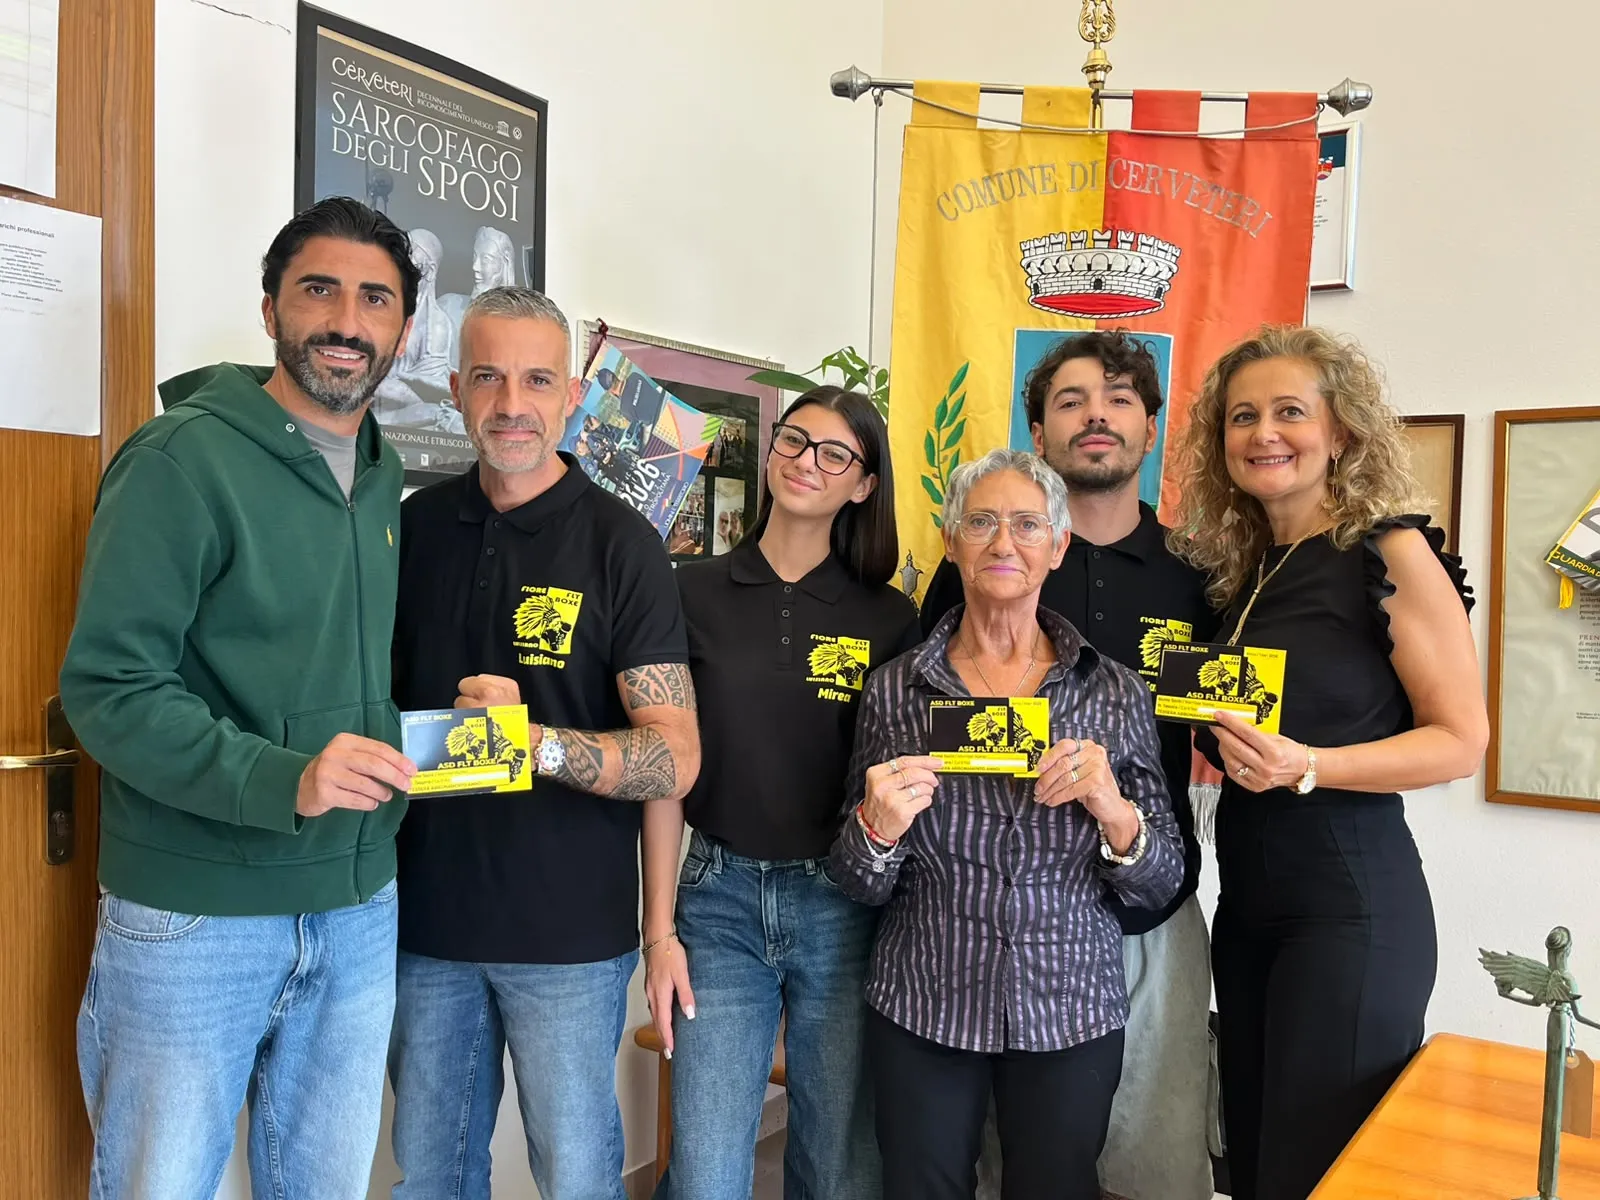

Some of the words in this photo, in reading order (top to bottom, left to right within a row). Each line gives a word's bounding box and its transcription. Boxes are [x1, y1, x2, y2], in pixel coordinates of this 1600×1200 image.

[417, 90, 452, 108] DECENNALE
[452, 103, 463, 112] DEL
[417, 98, 471, 123] RICONOSCIMENTO
[471, 117, 494, 131] UNESCO
[331, 91, 522, 181] SARCOFAGO
[332, 127, 409, 174] DEGLI
[418, 155, 519, 222] SPOSI
[937, 163, 1058, 221] COMUNE
[1069, 160, 1099, 192] DI
[1108, 157, 1274, 238] CERVETERI
[17, 226, 55, 238] professionali
[384, 431, 430, 444] NAZIONALE
[431, 437, 464, 448] ETRUSCO
[1551, 551, 1596, 574] GUARDIA
[521, 586, 547, 594] FIORE
[555, 597, 579, 606] BOXE
[1140, 617, 1165, 625] FIORE
[810, 634, 836, 642] FIORE
[519, 653, 565, 669] Luisiano
[818, 688, 851, 703] Mirea
[1186, 691, 1204, 699] ASD
[1205, 693, 1220, 701] FLT
[1221, 695, 1245, 703] BOXE
[404, 714, 420, 722] ASD
[437, 762, 456, 770] ASD
[473, 759, 497, 767] BOXE
